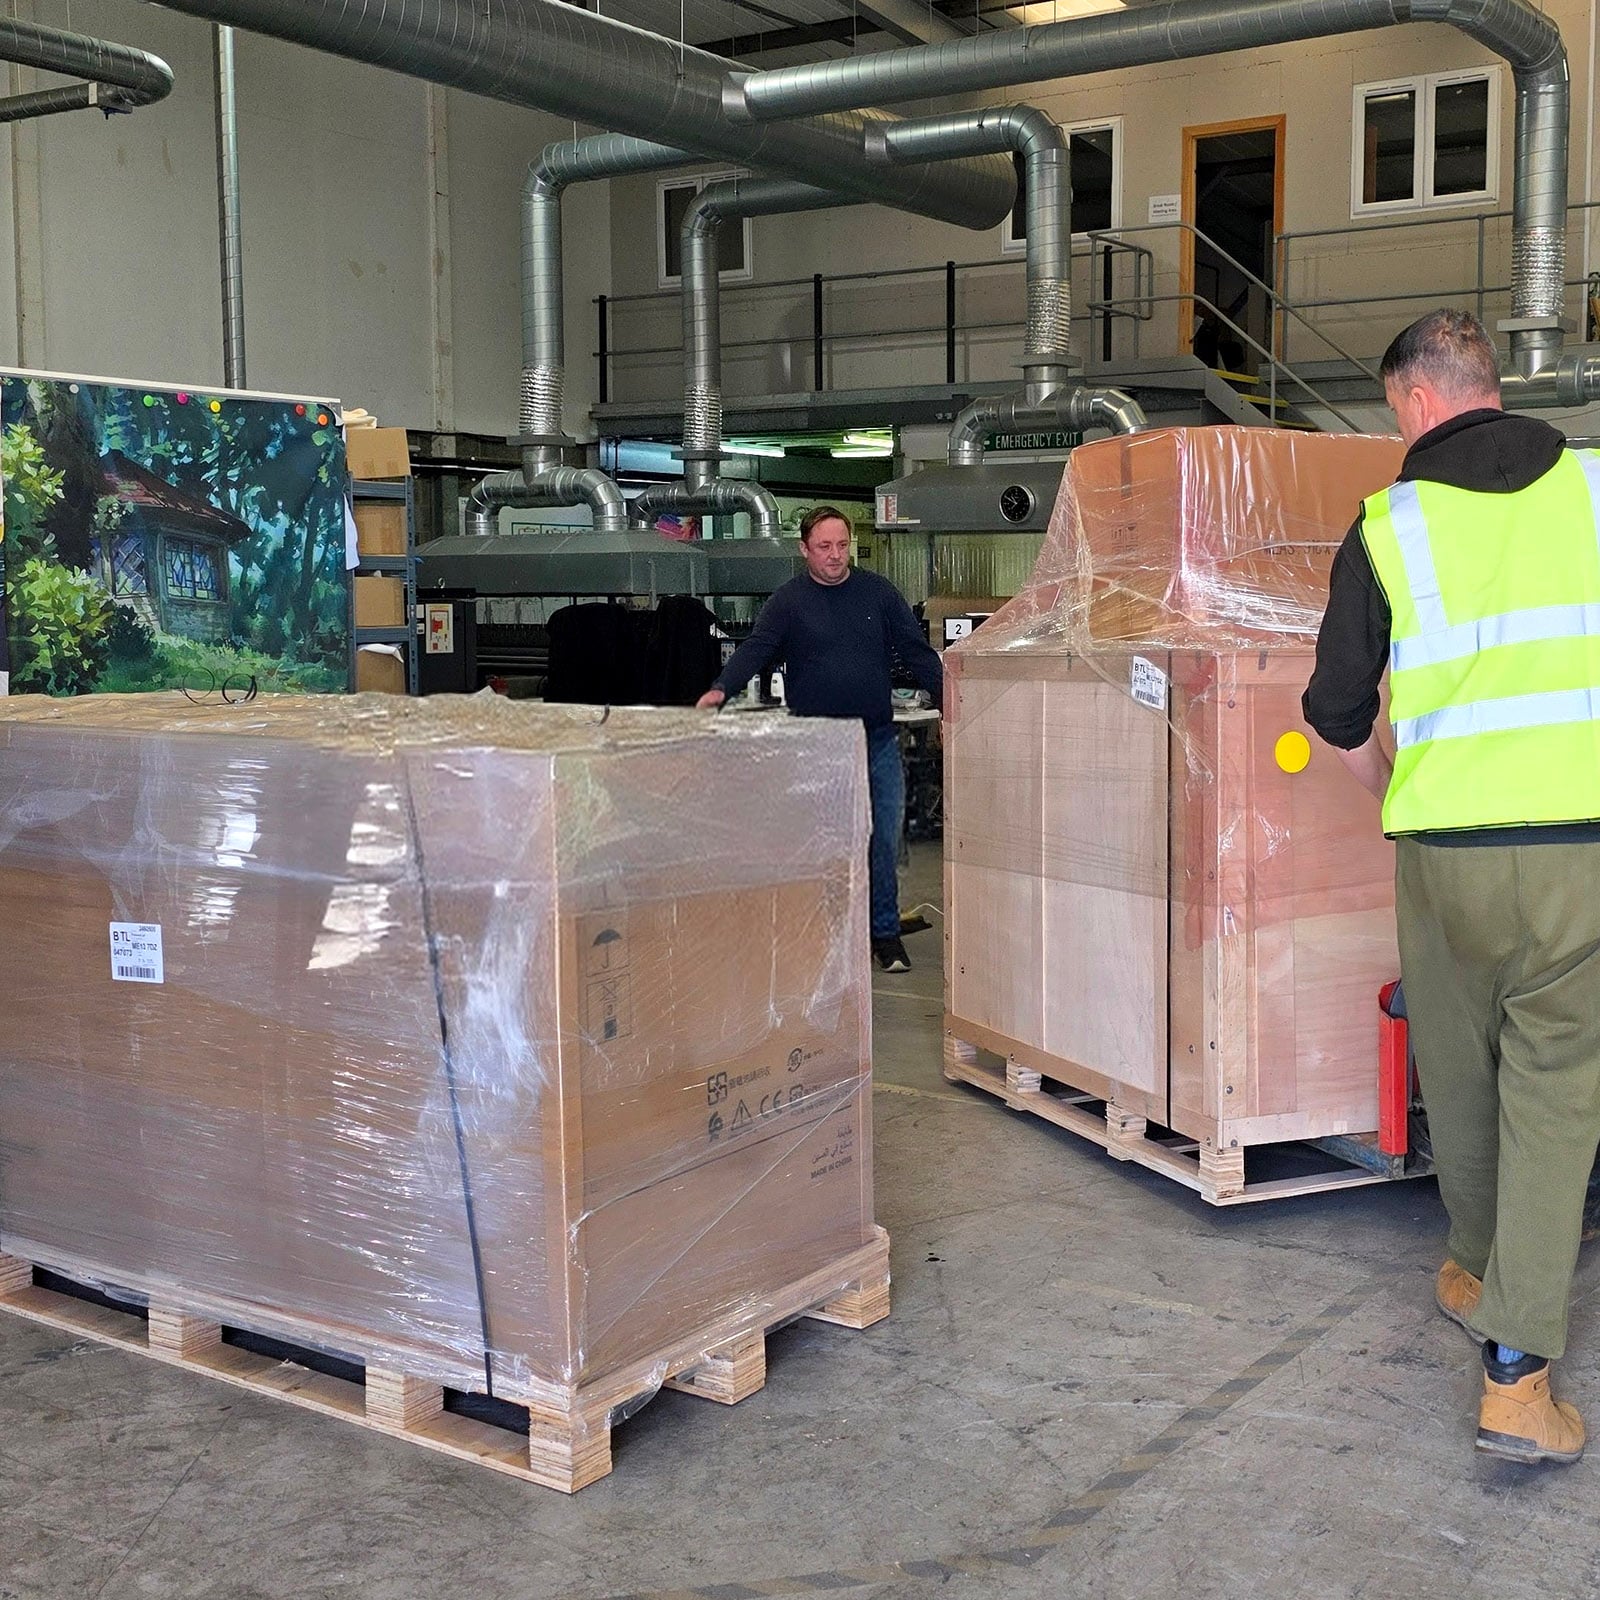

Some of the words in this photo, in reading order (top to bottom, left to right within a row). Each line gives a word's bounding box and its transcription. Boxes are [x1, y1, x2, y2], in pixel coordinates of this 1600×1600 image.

[995, 433, 1051, 449] EMERGENCY
[1056, 431, 1079, 447] EXIT
[955, 623, 962, 635] 2
[811, 1166, 827, 1179] MADE
[835, 1156, 853, 1169] CHINA
